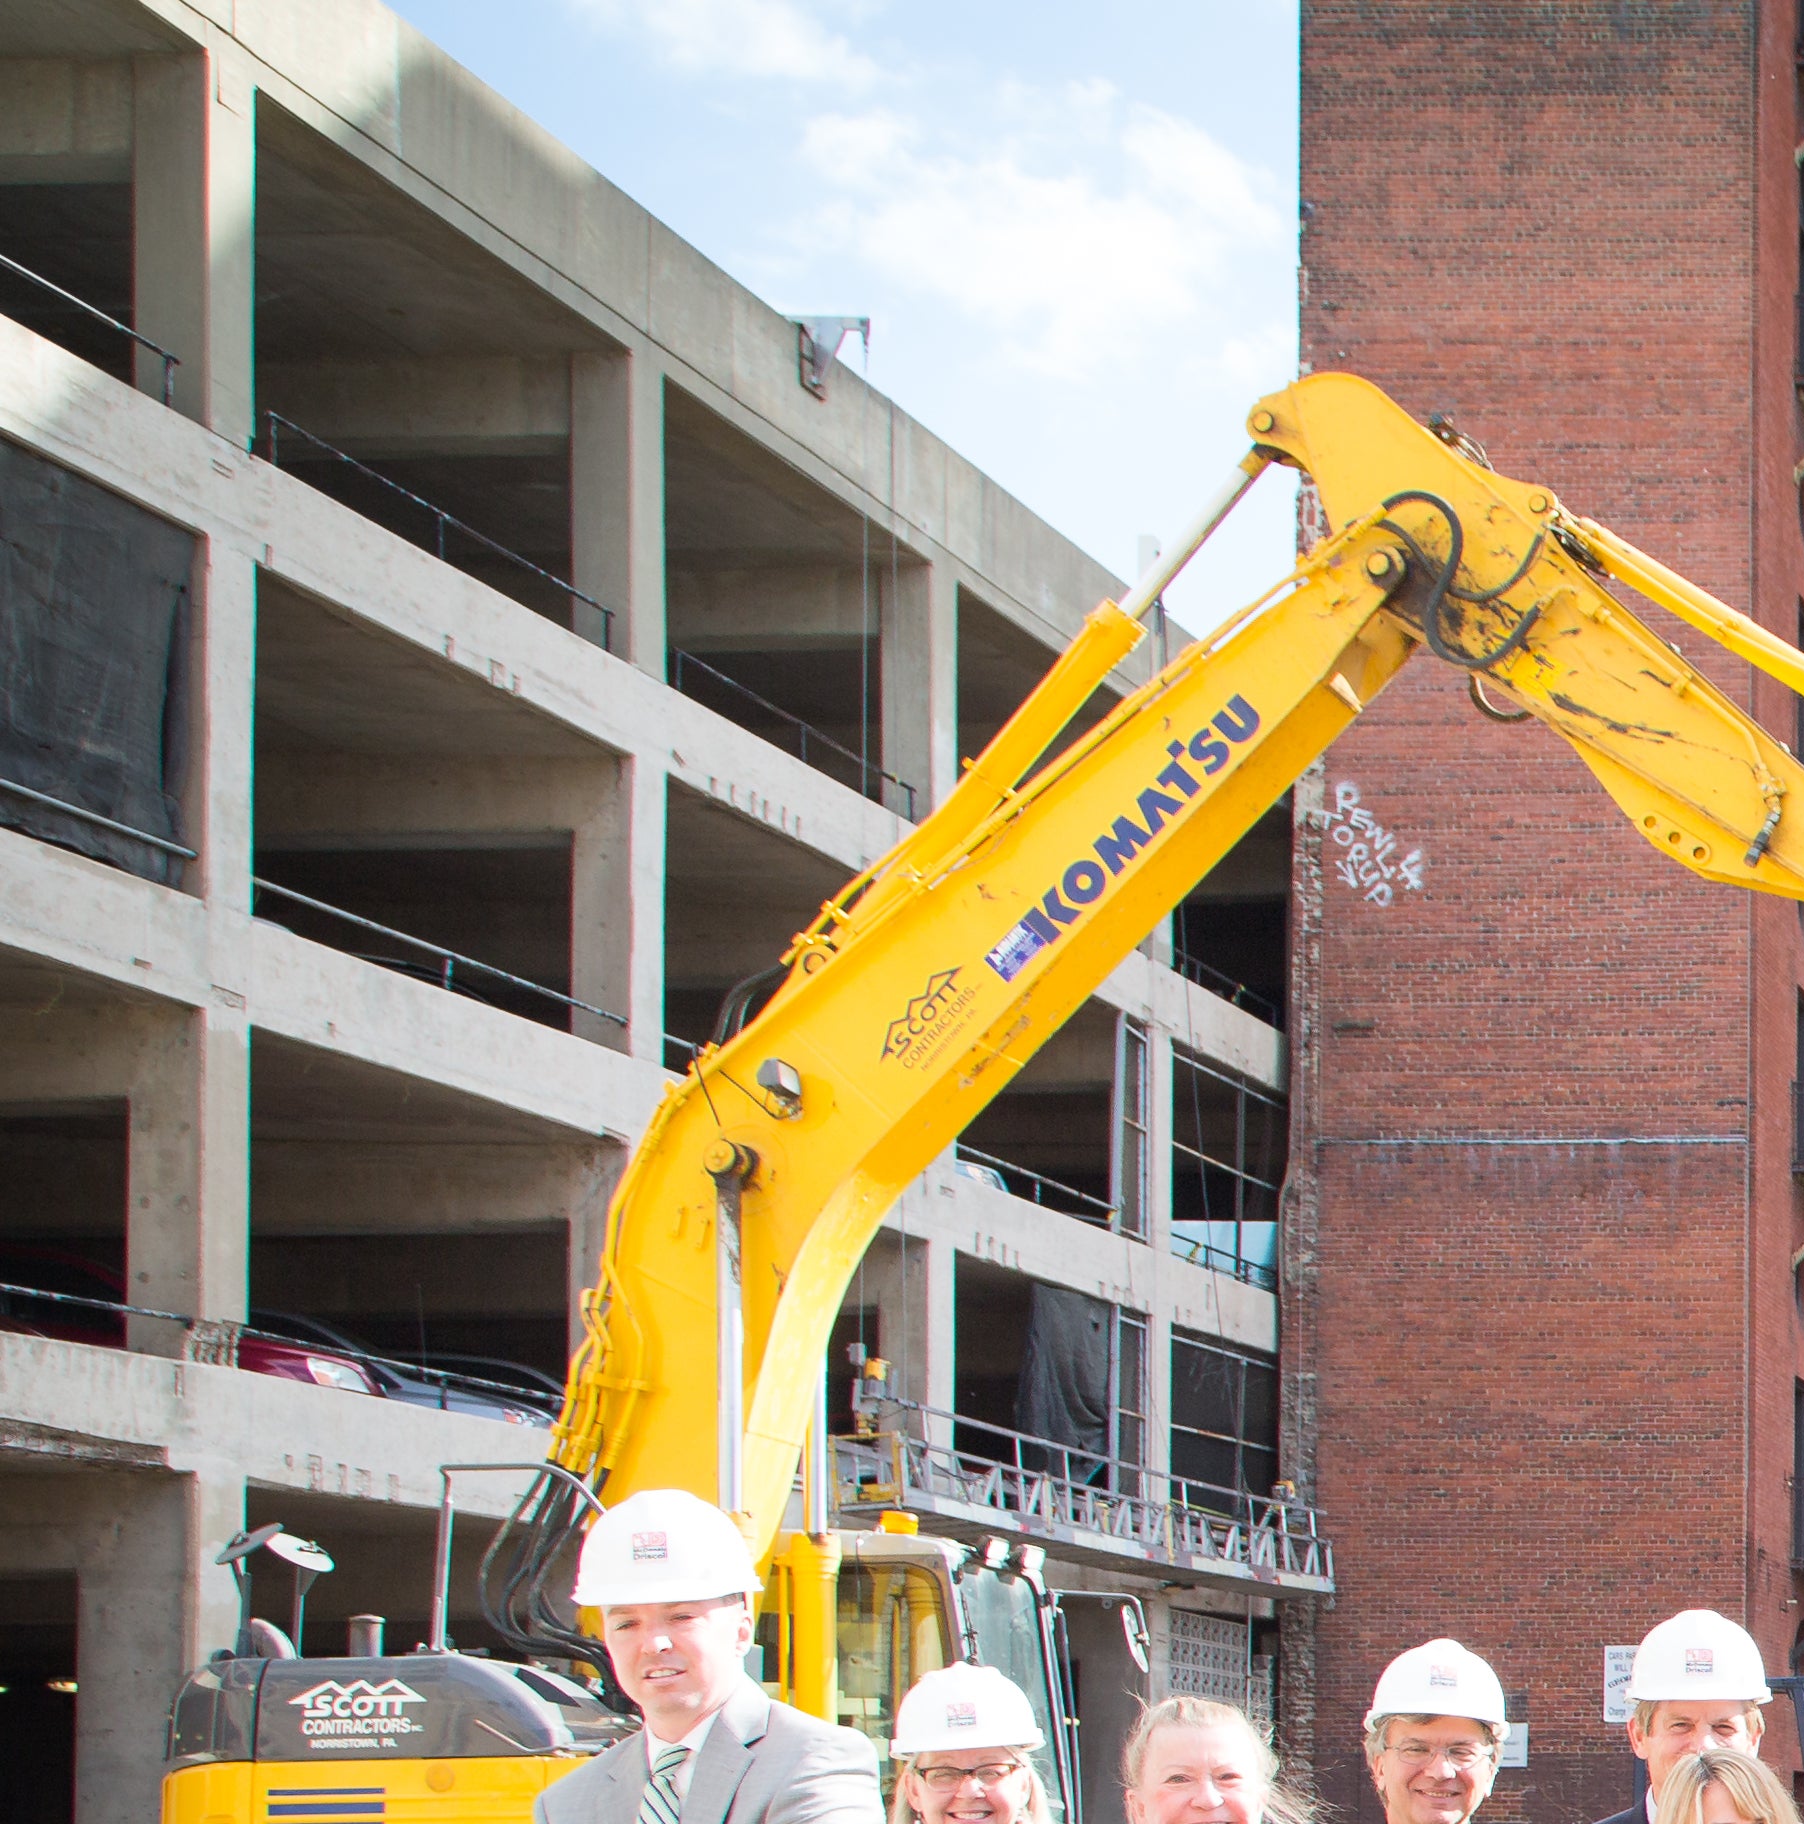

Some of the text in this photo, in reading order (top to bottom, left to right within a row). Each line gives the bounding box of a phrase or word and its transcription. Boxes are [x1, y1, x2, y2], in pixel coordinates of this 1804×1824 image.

[1024, 694, 1260, 945] KOMATSU
[303, 1694, 404, 1718] SCOTT
[302, 1718, 411, 1735] CONTRACTORS
